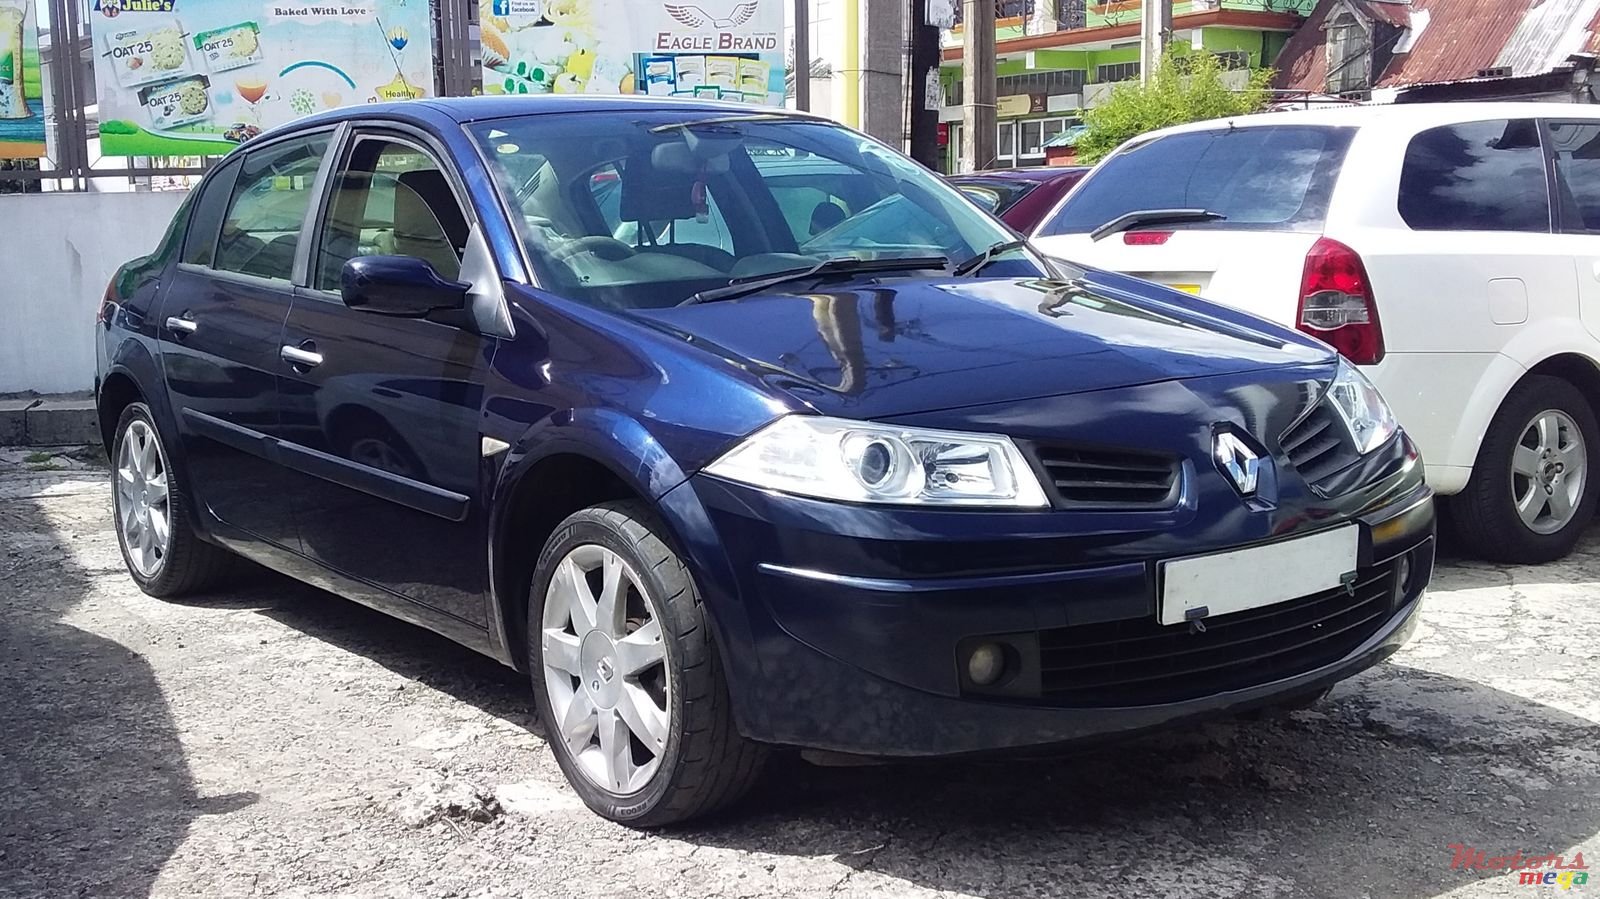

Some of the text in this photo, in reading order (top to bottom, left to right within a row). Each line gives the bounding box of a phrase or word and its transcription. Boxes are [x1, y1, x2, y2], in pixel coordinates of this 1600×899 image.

[122, 0, 171, 11] Julie's
[274, 7, 366, 16] Baked With Love
[204, 38, 234, 51] OAT 25
[656, 32, 777, 49] EAGLE BRAND
[113, 40, 153, 58] OAT 25
[150, 92, 182, 107] OAT 25
[385, 90, 416, 100] Healthy
